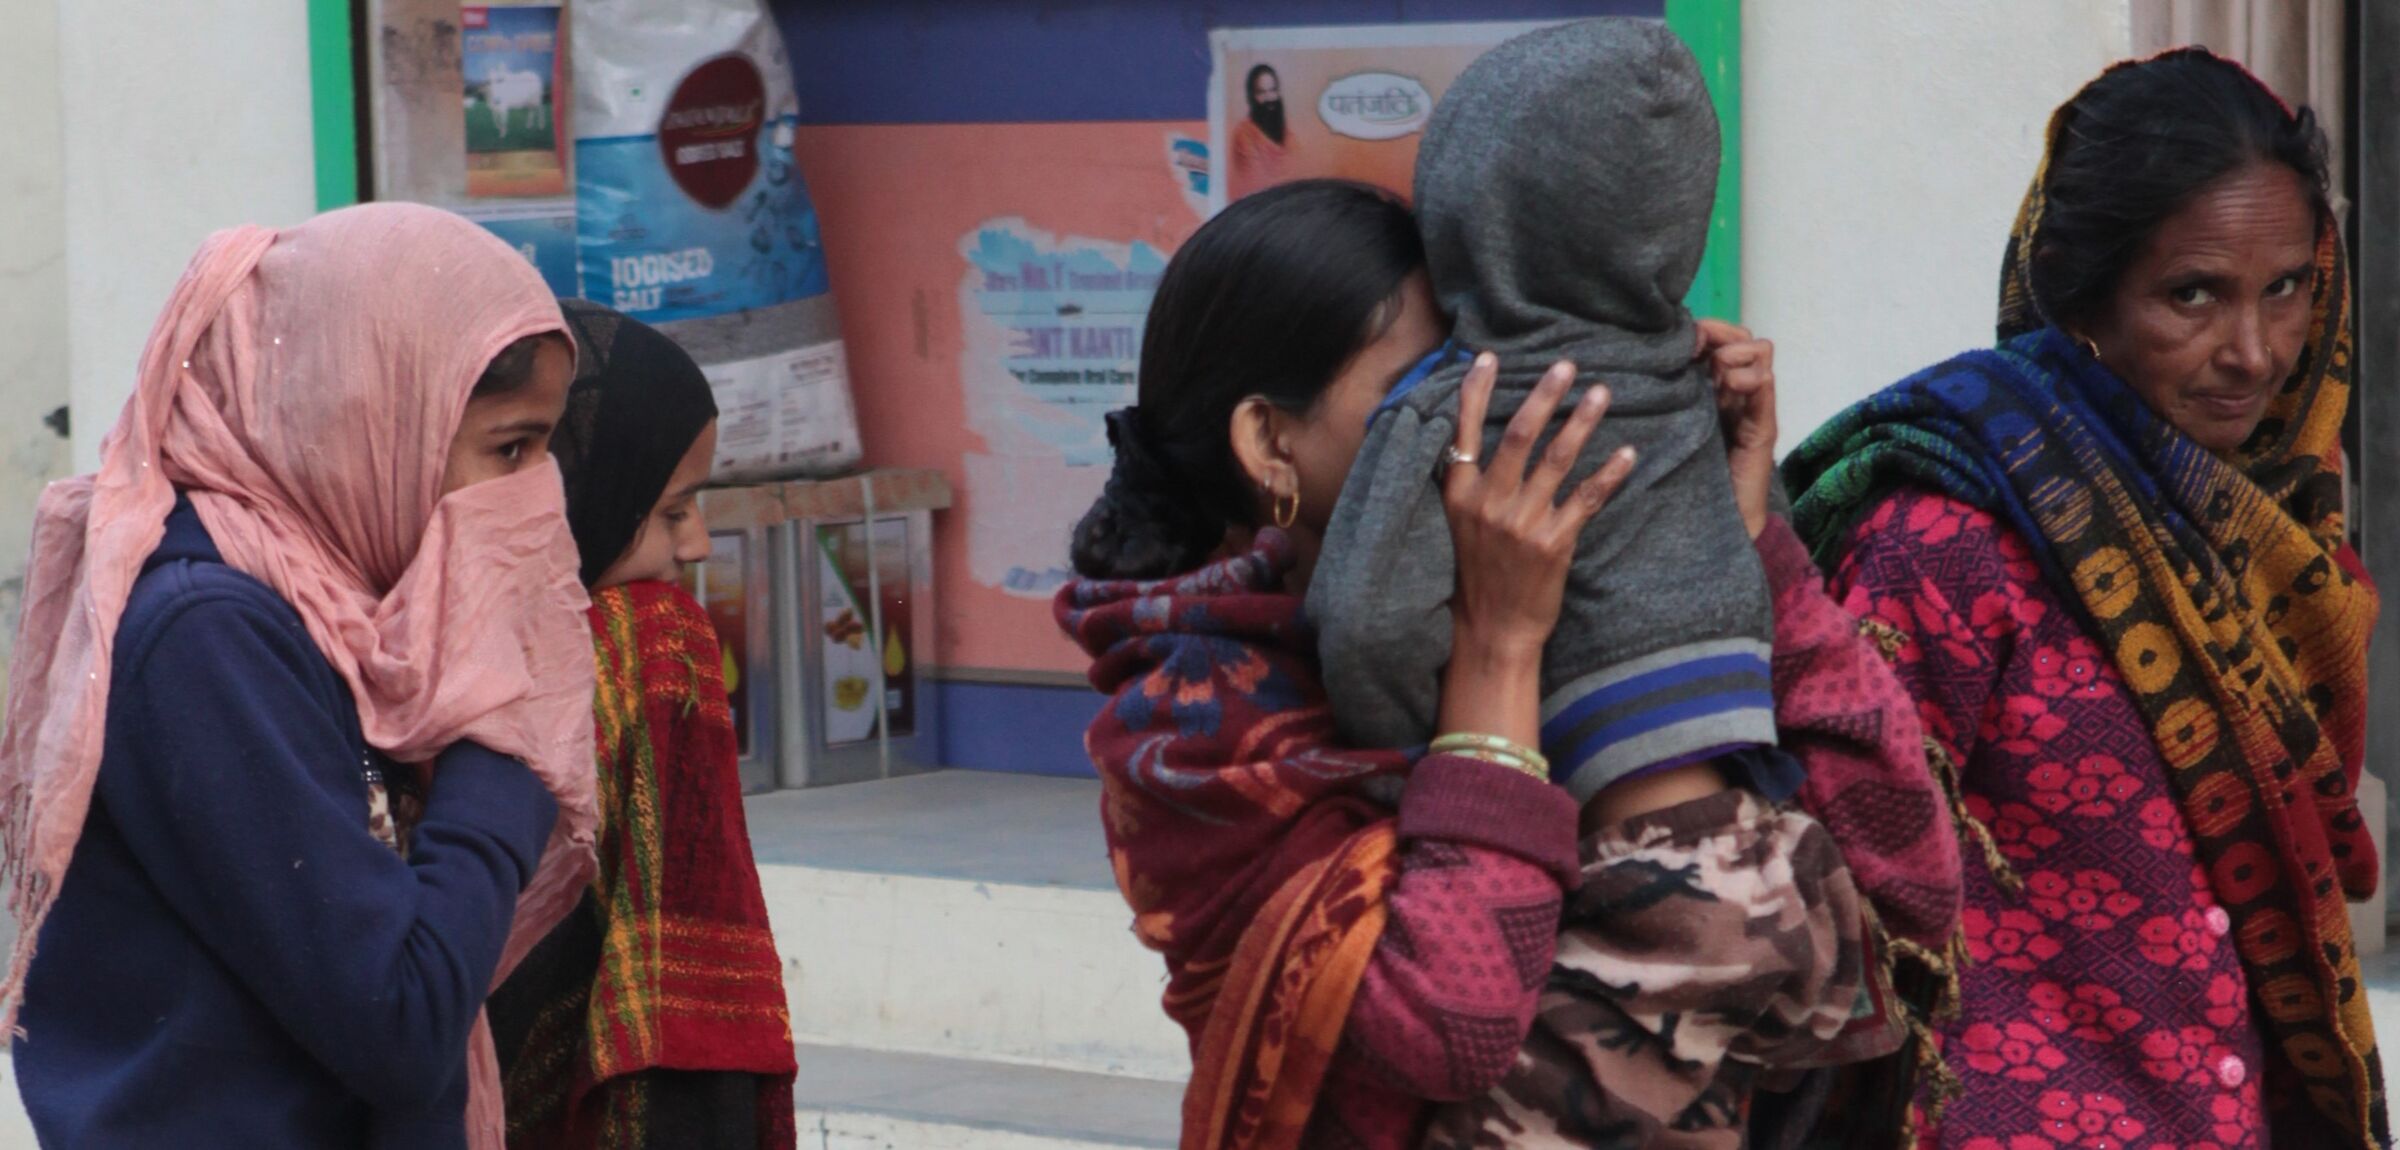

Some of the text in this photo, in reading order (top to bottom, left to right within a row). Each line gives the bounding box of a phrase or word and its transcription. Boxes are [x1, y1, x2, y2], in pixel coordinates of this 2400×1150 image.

[1328, 86, 1414, 116] पतंजलि
[610, 247, 714, 288] IODISED
[613, 286, 662, 313] SALT
[1069, 326, 1136, 359] KANTI
[1029, 369, 1082, 385] Complete
[1085, 369, 1107, 385] Oral
[1110, 369, 1135, 385] Care
